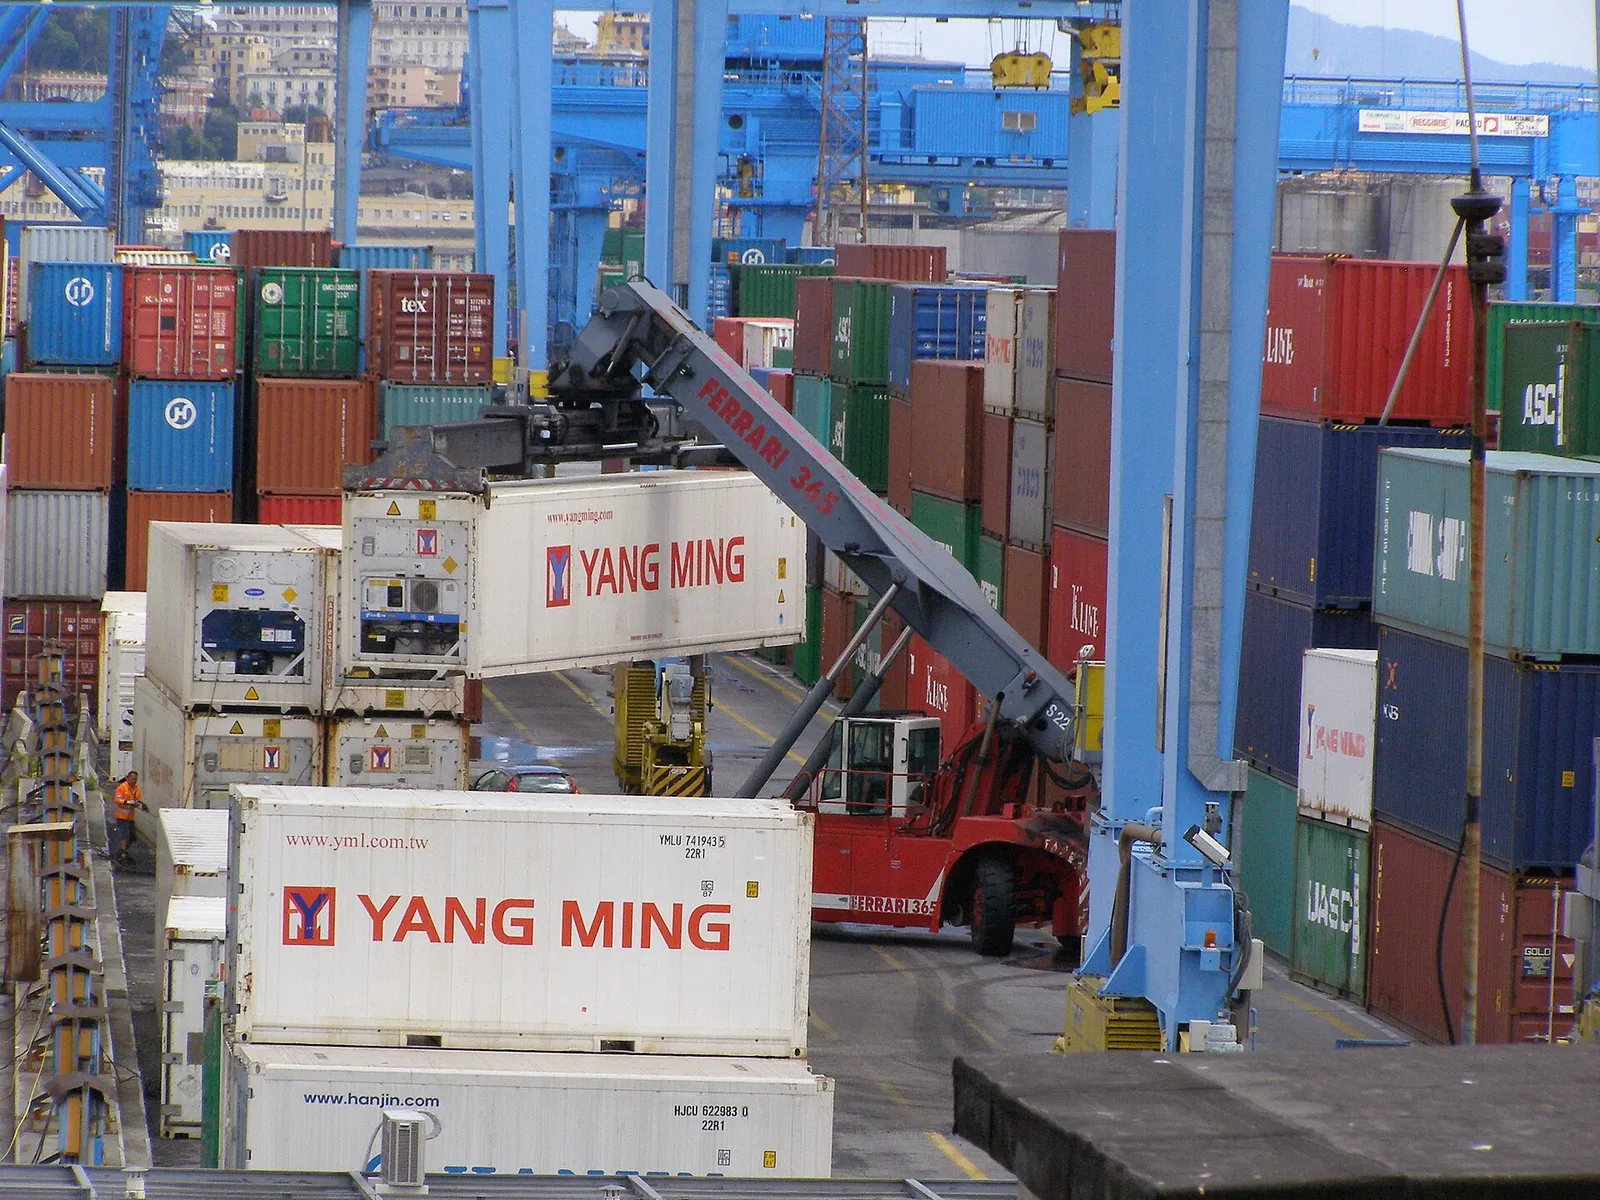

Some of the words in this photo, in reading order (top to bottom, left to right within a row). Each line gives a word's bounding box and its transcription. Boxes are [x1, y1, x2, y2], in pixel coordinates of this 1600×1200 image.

[401, 296, 427, 313] tex
[697, 376, 791, 471] FERRARI
[789, 465, 841, 516] 365
[547, 507, 613, 525] www.yangming.com
[579, 543, 660, 597] YANG
[670, 536, 745, 588] MING
[1046, 704, 1058, 717] S
[1053, 711, 1071, 731] 22
[286, 832, 430, 851] www.yml.com.tw
[659, 834, 682, 846] YMLU
[686, 835, 718, 847] 741943
[685, 847, 706, 859] 22R1
[1307, 880, 1353, 933] UASC
[357, 894, 535, 946] YANG
[560, 900, 732, 951] MING
[303, 1092, 440, 1109] www.hanjin.com
[674, 1105, 699, 1117] HJCU
[702, 1105, 738, 1117] 622983
[741, 1106, 749, 1118] 0
[701, 1120, 725, 1131] 22R1
